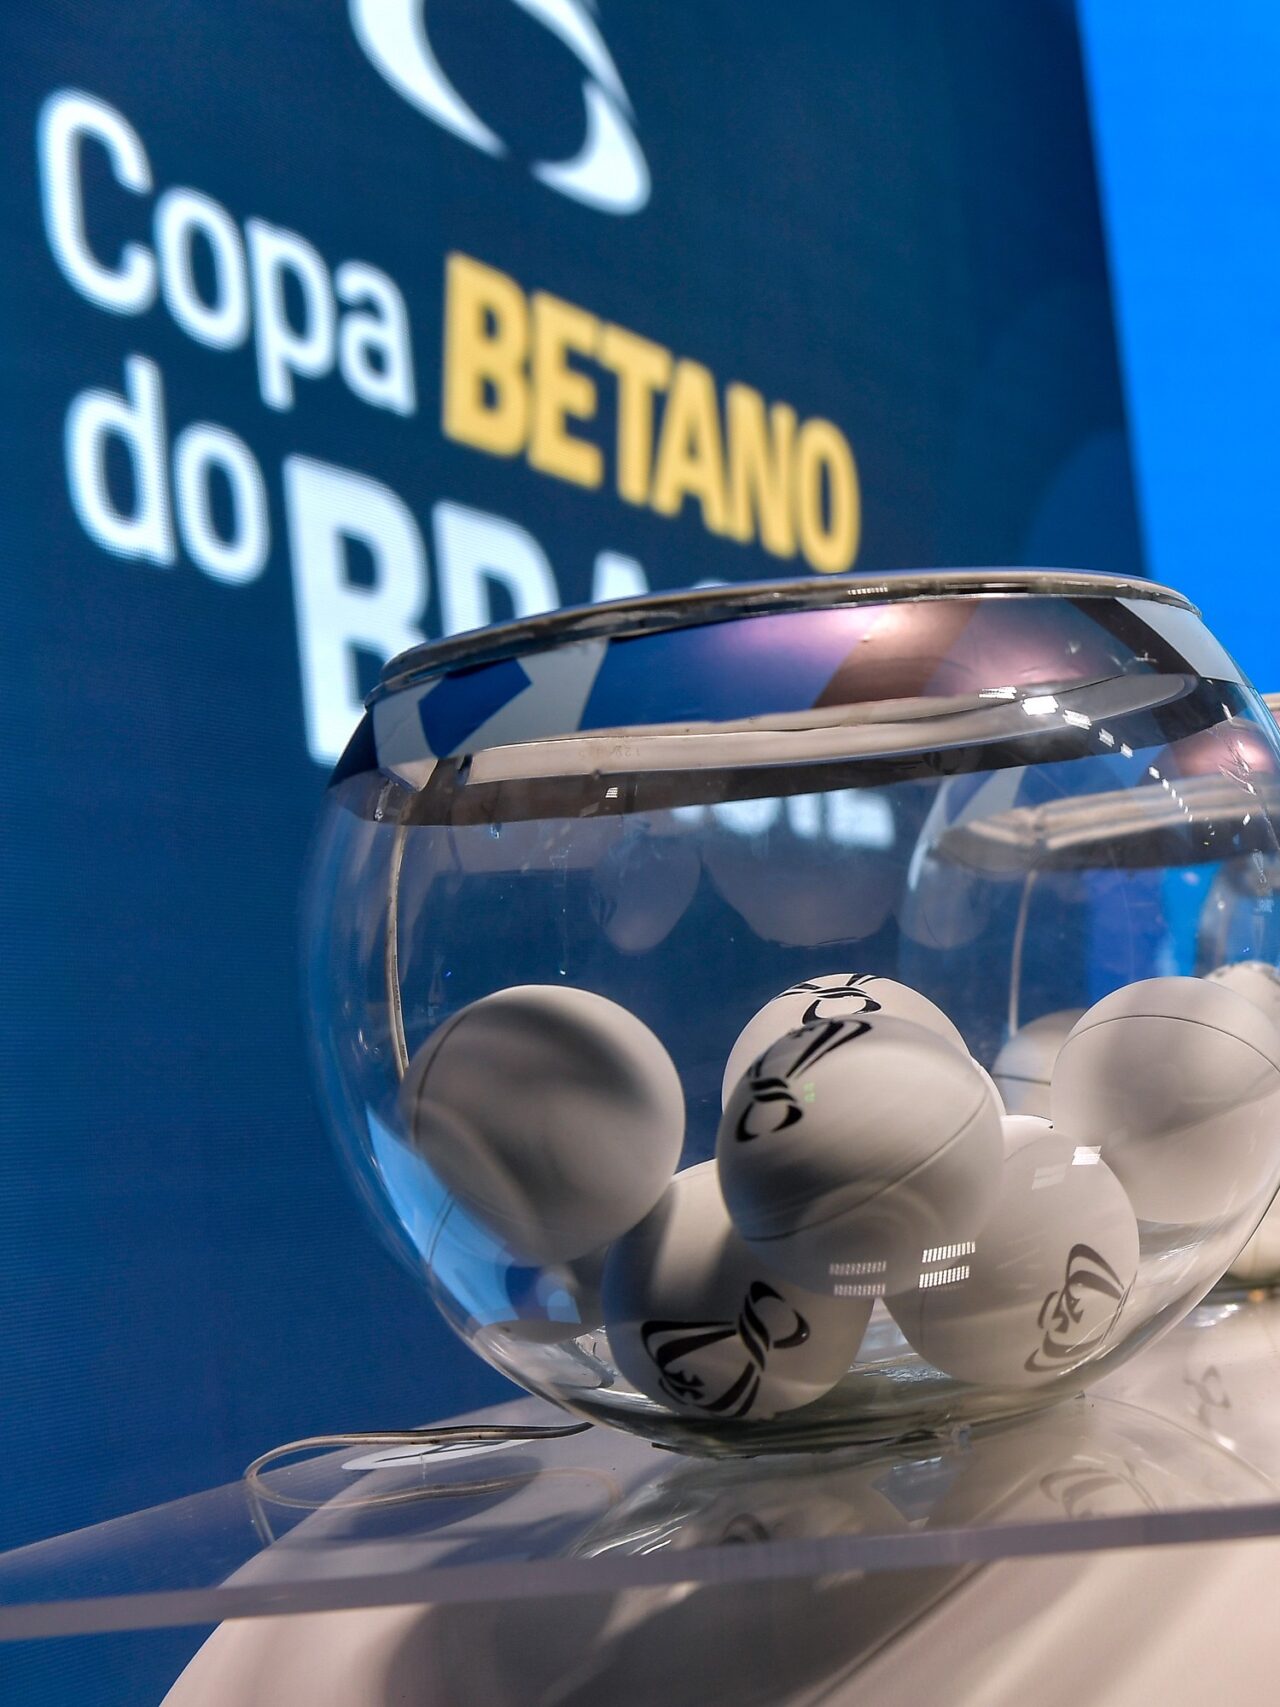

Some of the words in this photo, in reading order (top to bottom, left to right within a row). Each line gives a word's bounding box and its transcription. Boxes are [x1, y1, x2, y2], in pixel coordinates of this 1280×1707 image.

[39, 87, 416, 417] Copa
[443, 250, 861, 575] BETANO
[65, 355, 270, 586] do
